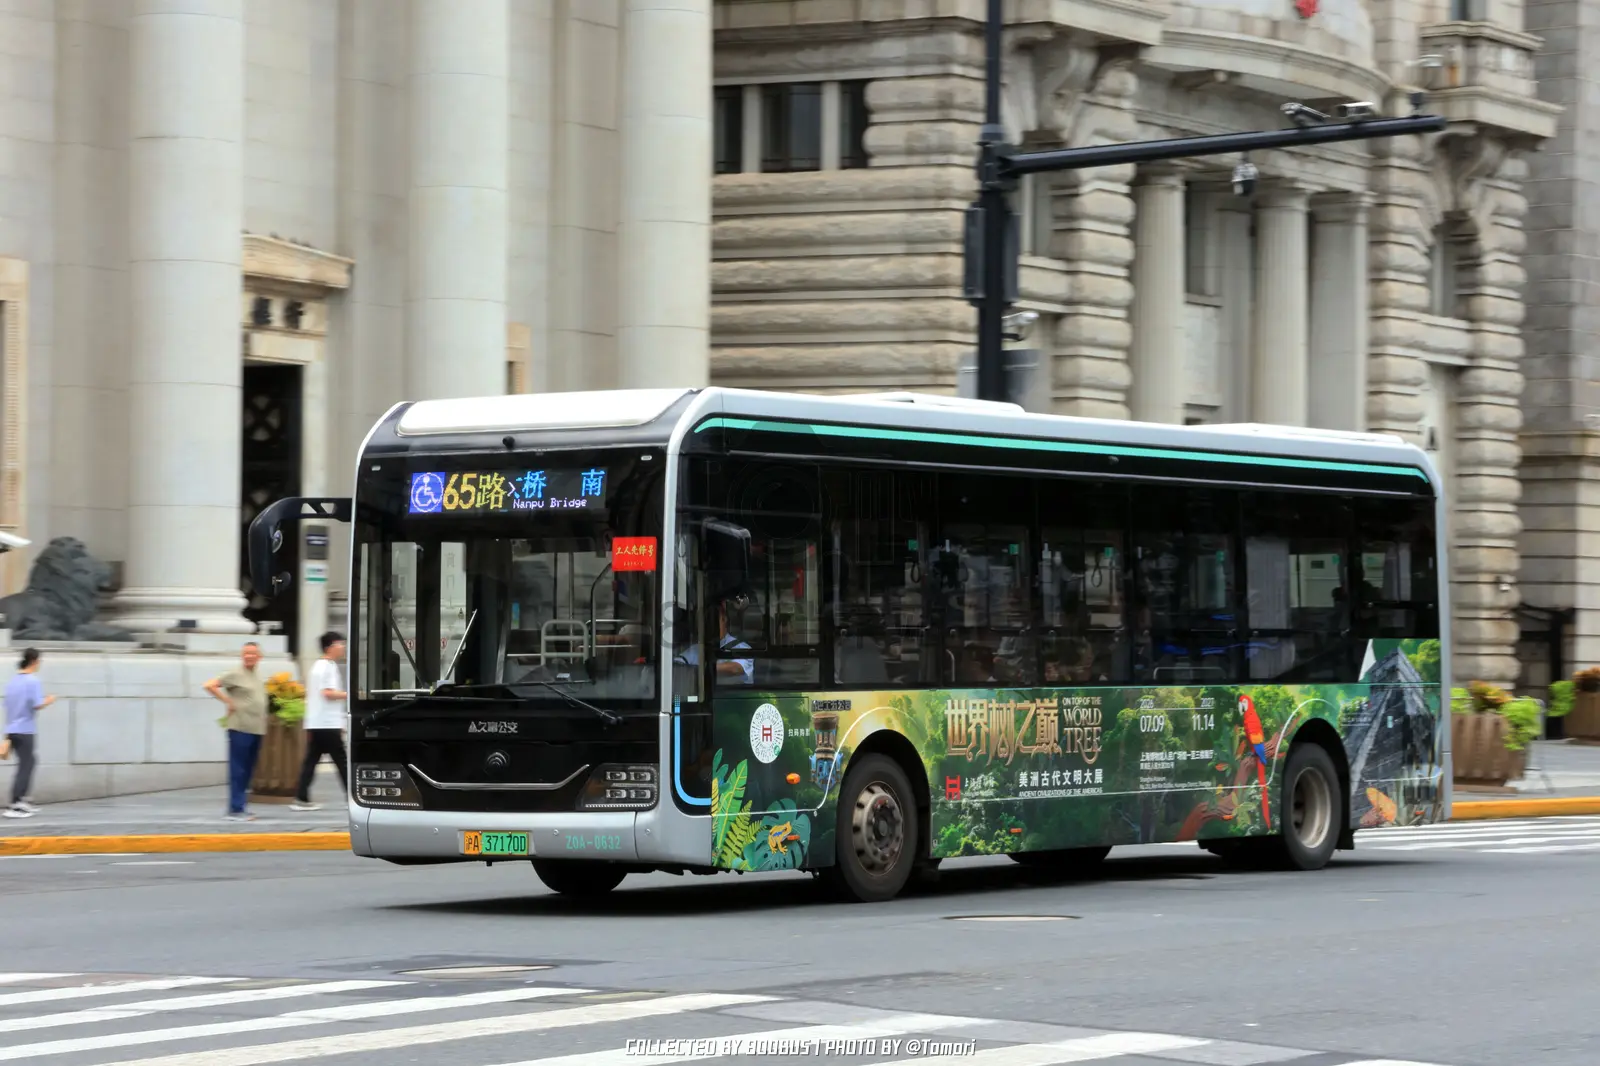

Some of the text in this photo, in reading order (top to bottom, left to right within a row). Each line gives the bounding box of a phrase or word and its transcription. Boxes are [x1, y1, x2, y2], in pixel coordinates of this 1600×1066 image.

[443, 472, 507, 510] 65路
[581, 468, 606, 497] 南
[513, 497, 588, 509] Nanpu Bridge
[1063, 706, 1102, 726] WORLD
[1140, 714, 1165, 732] 07.09
[1192, 713, 1215, 731] 11.14
[944, 698, 1062, 766] 世界树之巅
[1063, 727, 1102, 765] TREE
[1019, 769, 1103, 788] 美洲古代文明大展
[485, 835, 526, 851] 37170D
